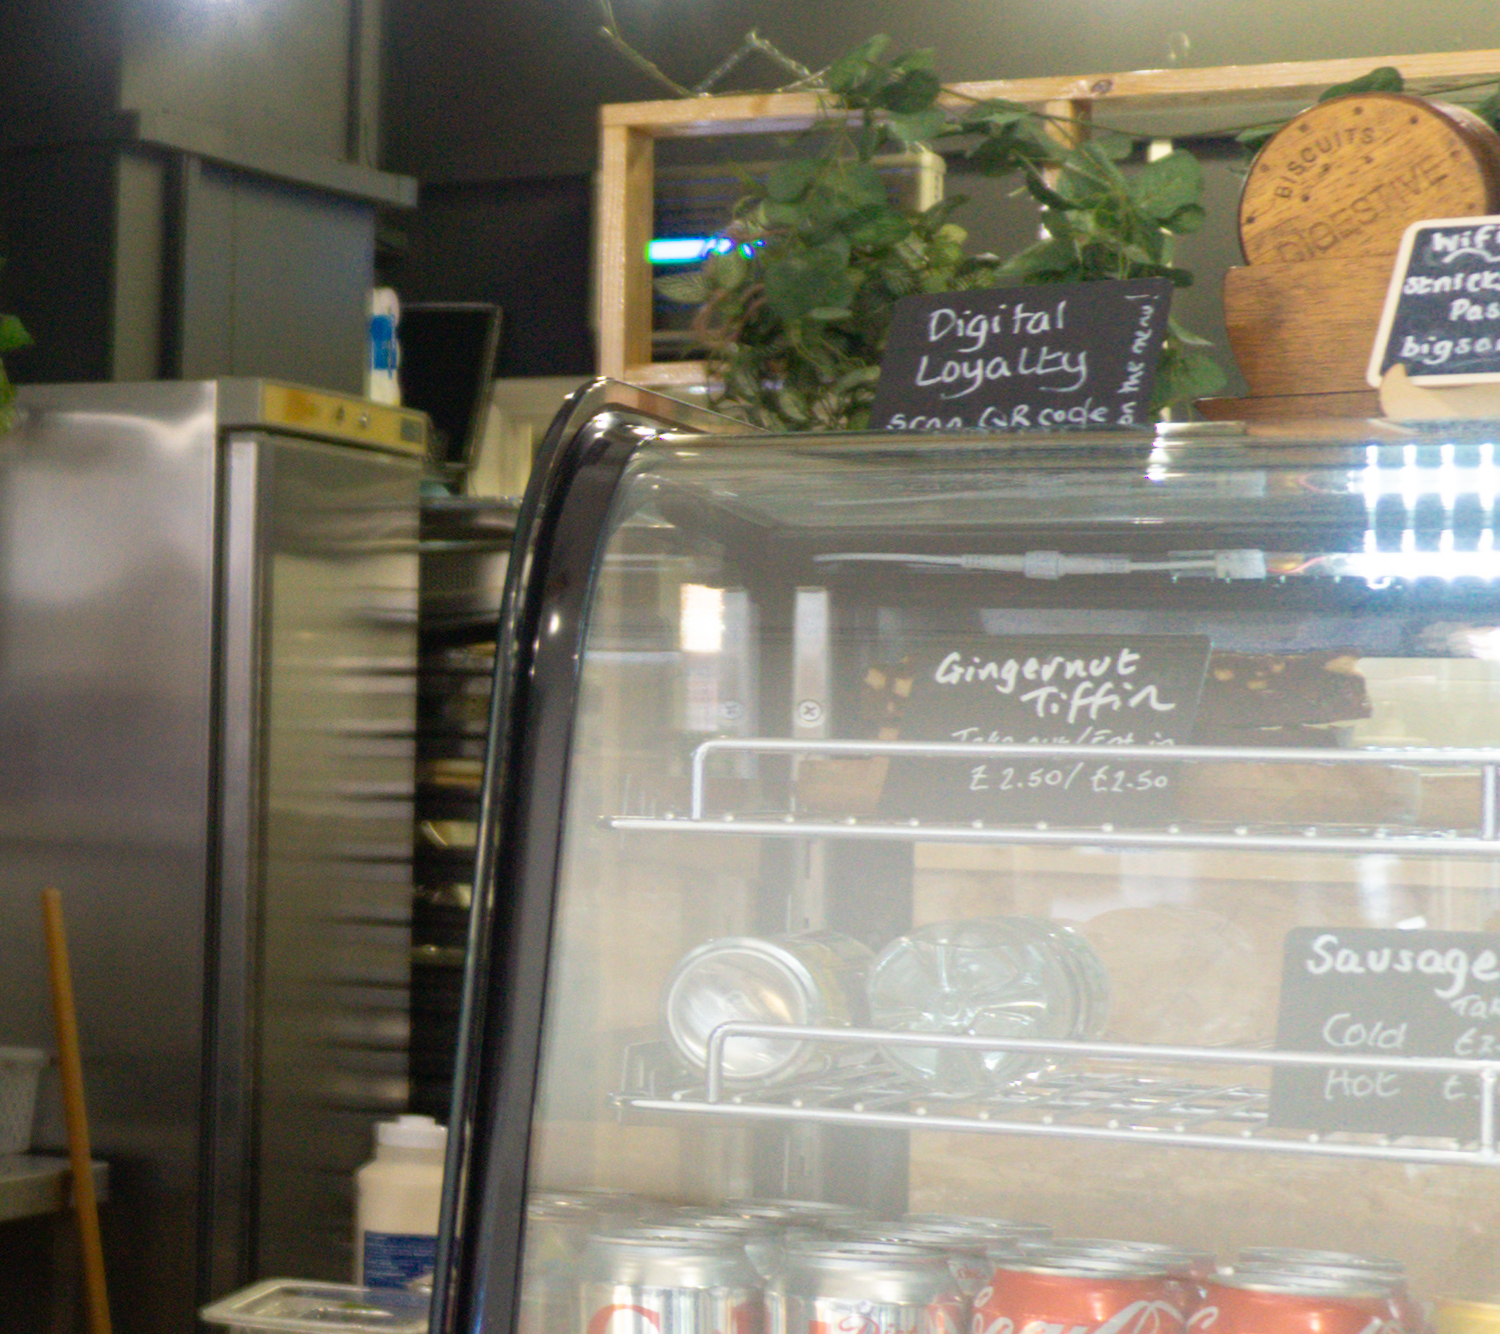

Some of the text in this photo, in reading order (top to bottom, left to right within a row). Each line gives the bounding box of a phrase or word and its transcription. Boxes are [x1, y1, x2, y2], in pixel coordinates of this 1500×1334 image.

[1274, 127, 1375, 200] BISCUITS
[1276, 154, 1449, 263] DIGESTIVE
[929, 300, 1066, 353] Digital
[915, 346, 1087, 399] Loyalty
[1037, 397, 1109, 427] code
[934, 648, 1140, 694] Gingernut
[1019, 680, 1176, 723] Tiffin
[1306, 934, 1500, 999] Sausage
[1323, 1012, 1409, 1048] Cold
[1324, 1069, 1401, 1101] Hot
